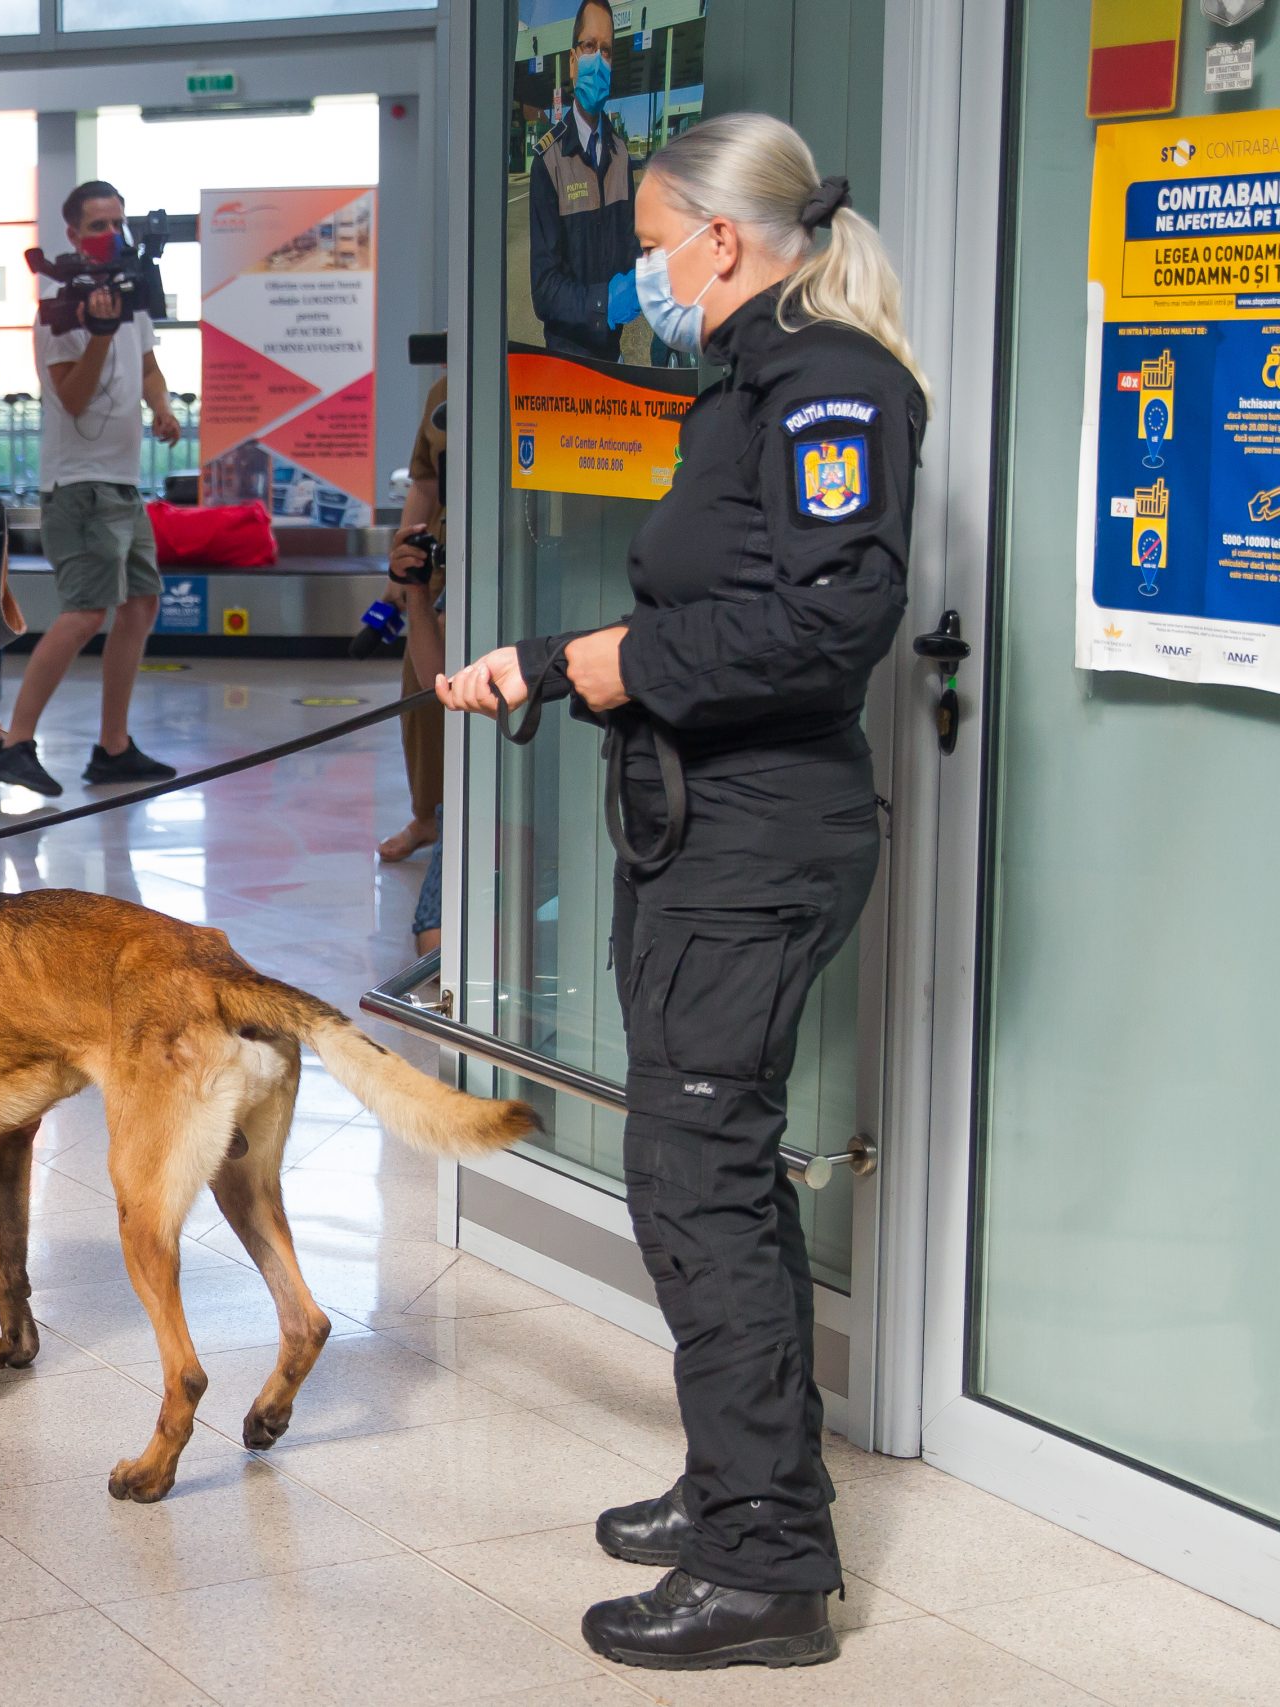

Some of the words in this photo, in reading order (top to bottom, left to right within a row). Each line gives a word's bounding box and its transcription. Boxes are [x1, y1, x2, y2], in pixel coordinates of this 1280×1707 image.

[1161, 139, 1196, 167] STOP
[1157, 180, 1280, 212] CONTRABAN
[1155, 215, 1174, 232] NE
[1175, 207, 1252, 231] AFECTEAZĂ
[1253, 209, 1272, 227] PE
[1155, 247, 1199, 265] LEGEA
[1203, 246, 1212, 263] O
[1215, 243, 1280, 263] CONDAM
[1154, 265, 1250, 286] CONDAMN-O
[579, 399, 592, 415] UN
[629, 401, 642, 417] AL
[560, 434, 573, 449] Call
[574, 436, 597, 449] Center
[1162, 646, 1192, 657] ANAF
[1227, 652, 1258, 664] ANAF
